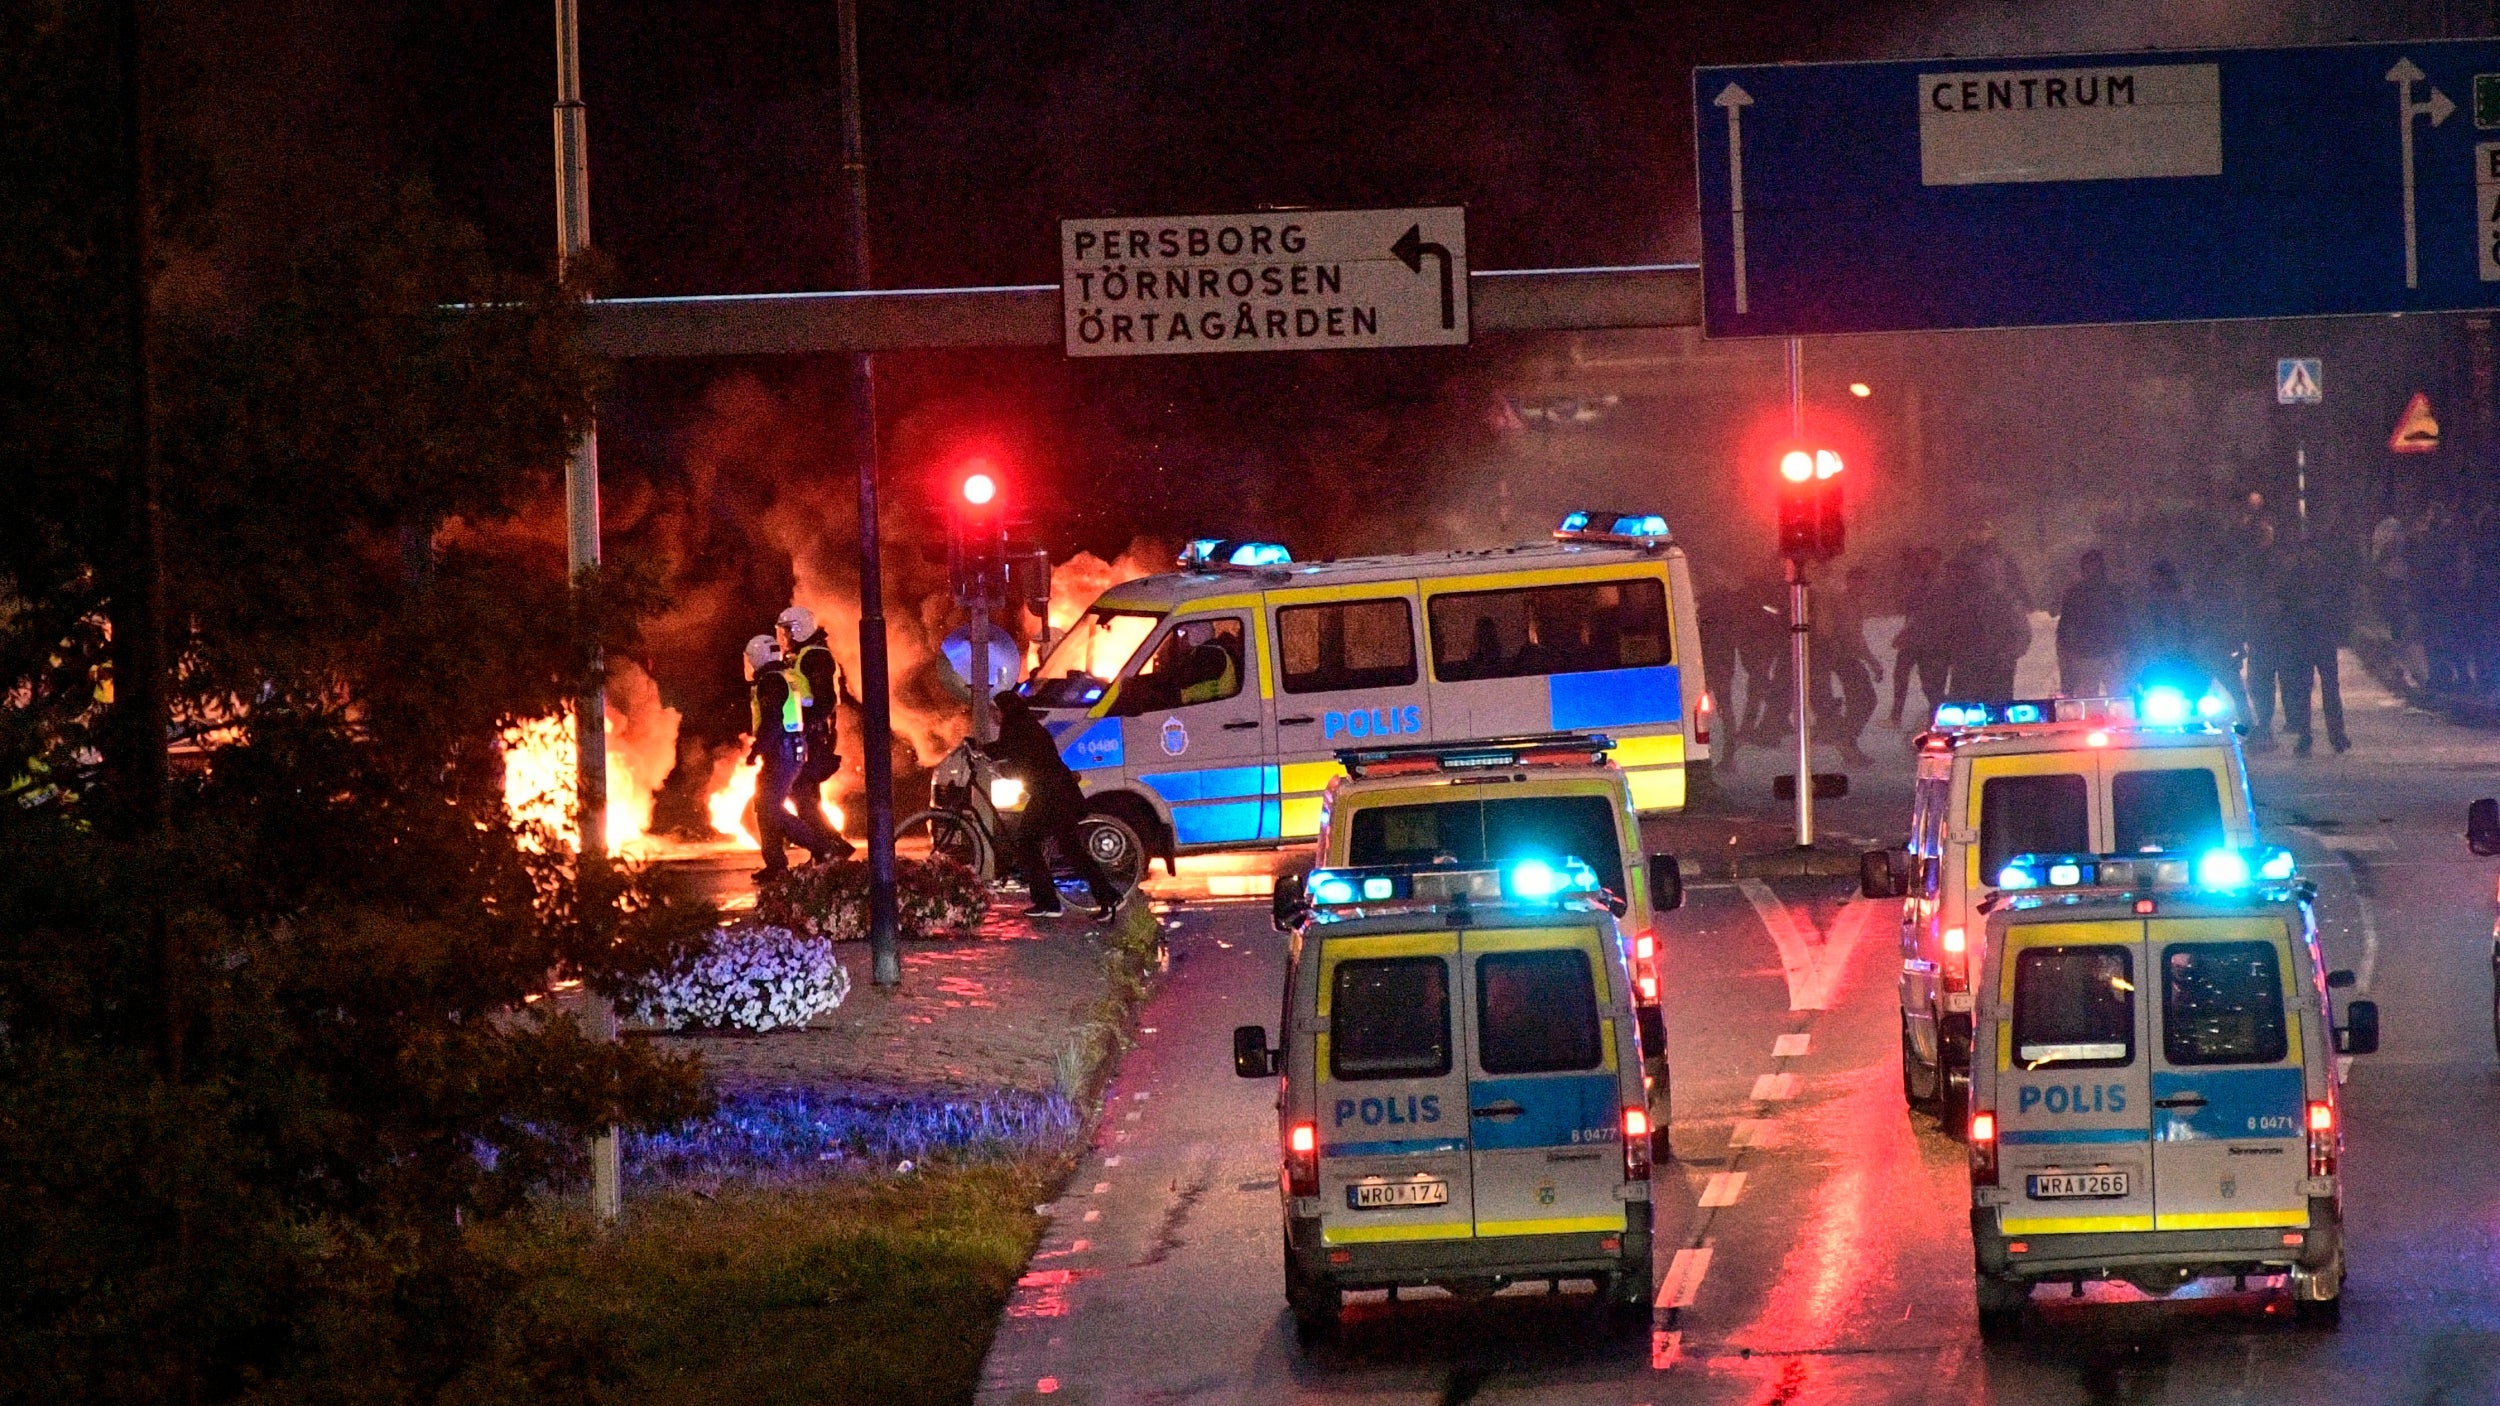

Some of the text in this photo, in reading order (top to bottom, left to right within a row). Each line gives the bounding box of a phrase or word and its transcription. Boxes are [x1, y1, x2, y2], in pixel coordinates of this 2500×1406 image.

[1932, 75, 2136, 112] CENTRUM
[1075, 224, 1306, 261] PERSBORG
[1076, 264, 1341, 301] TÖRNROSEN
[1078, 302, 1378, 344] ÖRTAGÅRDEN
[1324, 704, 1422, 740] POLIS
[1335, 1094, 1441, 1128] POLIS
[2019, 1084, 2127, 1115] POLIS
[1584, 1127, 1617, 1142] 0477
[2260, 1116, 2293, 1129] 0471
[1360, 1184, 1443, 1204] WRO 174
[2040, 1176, 2124, 1194] WRA 266
